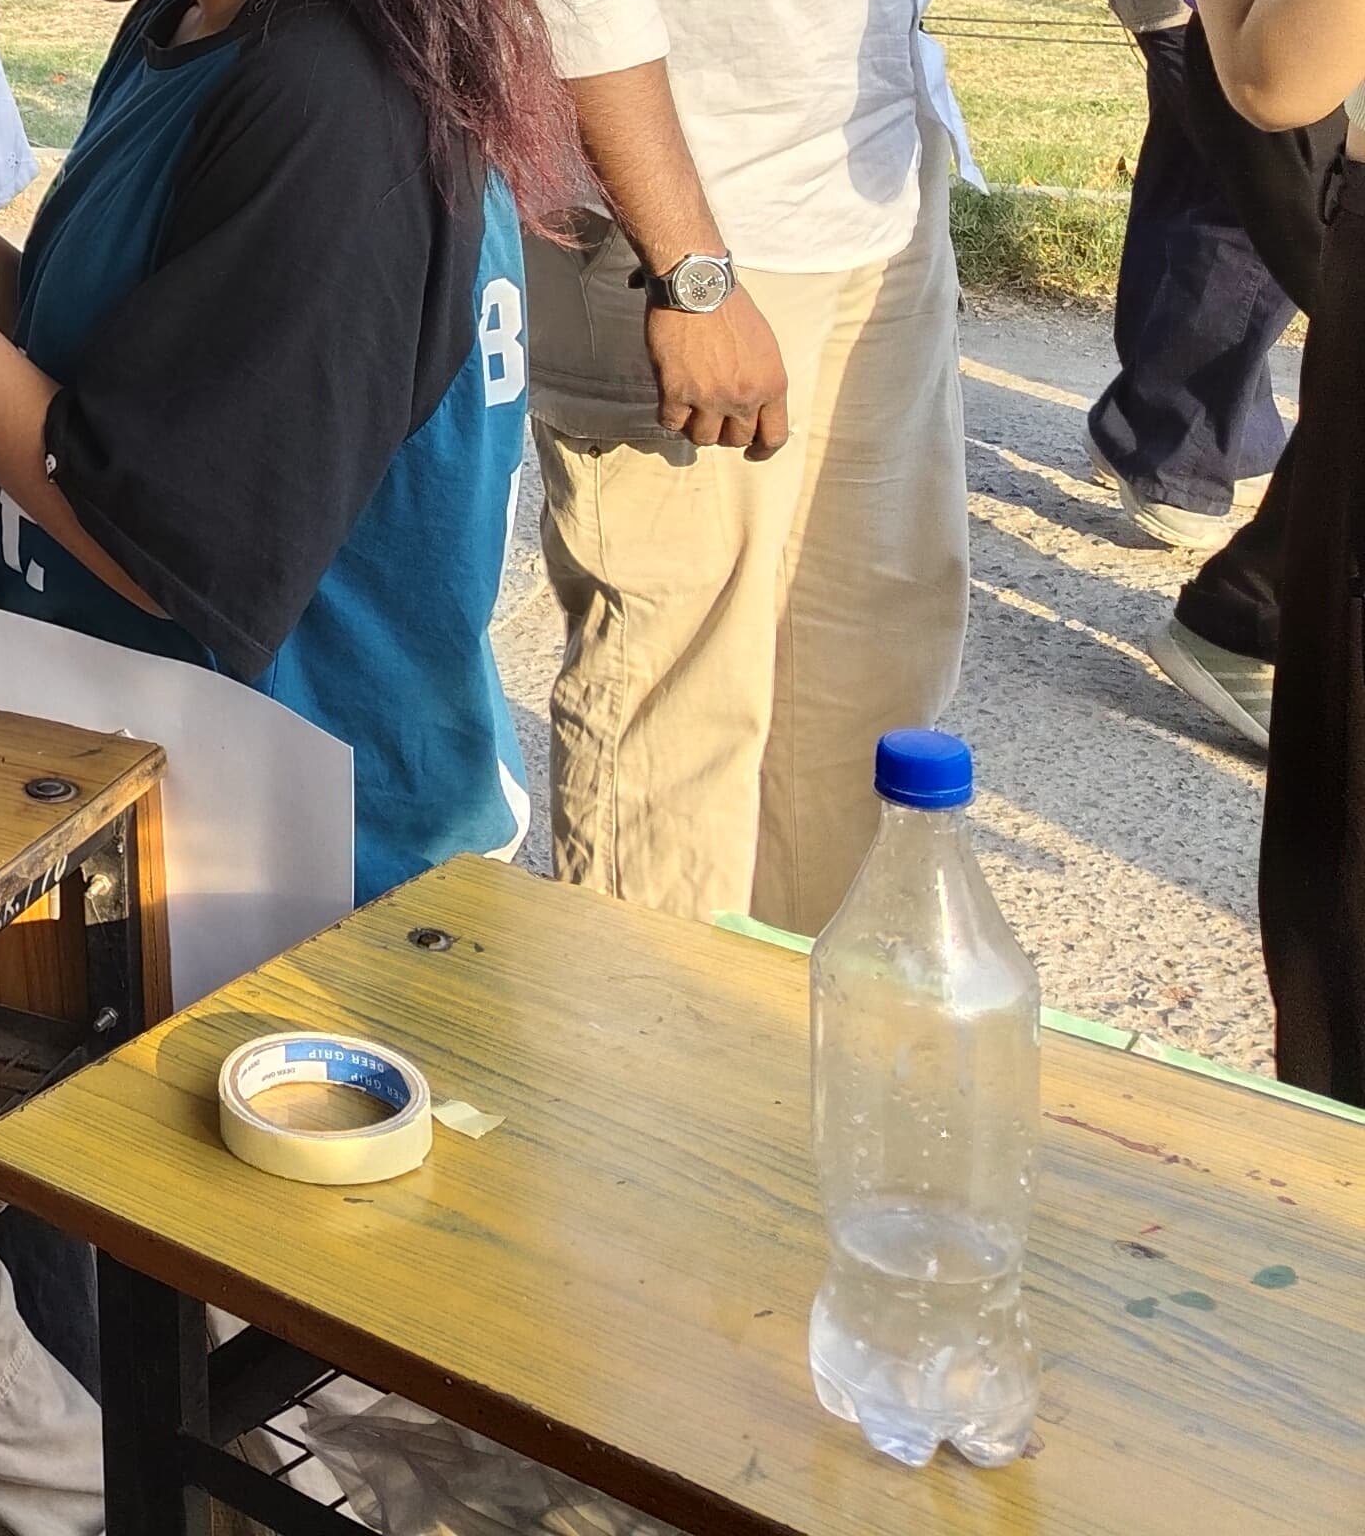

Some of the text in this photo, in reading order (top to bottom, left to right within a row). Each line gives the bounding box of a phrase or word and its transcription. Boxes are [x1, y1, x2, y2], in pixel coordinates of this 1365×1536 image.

[308, 1048, 385, 1074] DEER GRIP
[277, 1067, 296, 1077] DEER
[350, 1072, 382, 1092] GRIP
